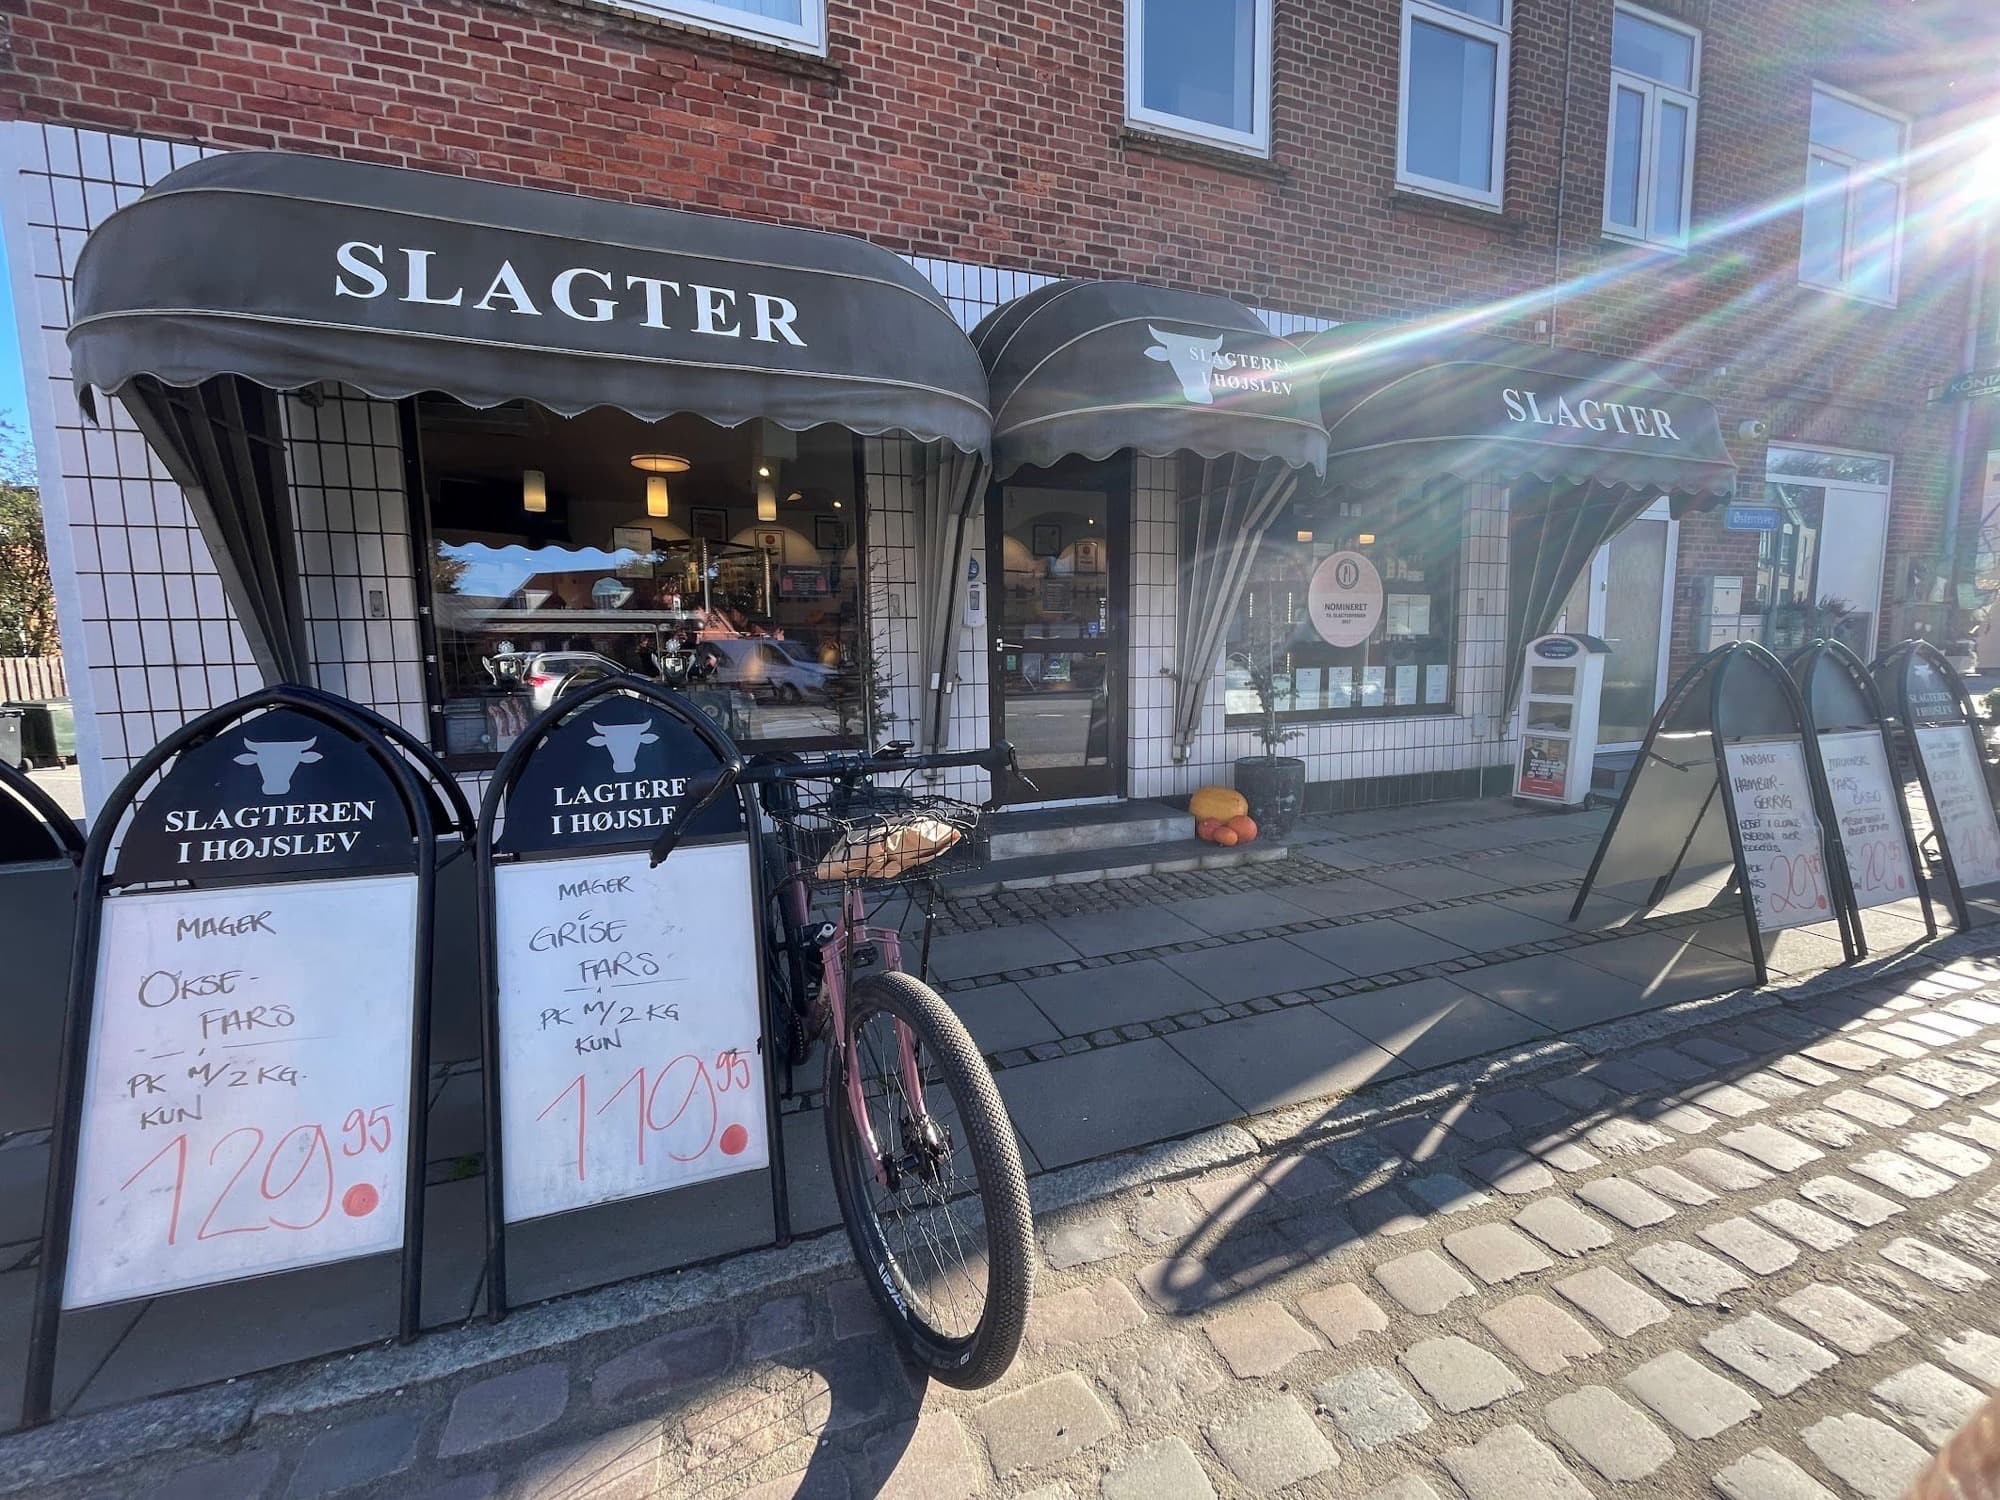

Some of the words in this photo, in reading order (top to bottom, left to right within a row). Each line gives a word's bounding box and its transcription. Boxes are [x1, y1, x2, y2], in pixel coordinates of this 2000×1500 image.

[335, 241, 808, 347] SLAGTER
[1189, 346, 1293, 373] SLAGTEREN
[1213, 373, 1292, 396] HØJSLEV
[1501, 387, 1681, 441] SLAGTER
[1324, 602, 1368, 611] NOMINERET
[553, 777, 692, 806] LAGTERE
[165, 800, 376, 833] SLAGTEREN
[551, 815, 563, 834] I
[570, 805, 677, 833] HØJSLE
[177, 842, 192, 864] I
[199, 831, 361, 863] HØJSLEV
[559, 875, 634, 900] MAGER
[176, 910, 276, 942] MAGER
[579, 951, 660, 984] FARS
[200, 1004, 296, 1040] FARS
[540, 1008, 574, 1030] PK
[646, 1003, 680, 1022] KG
[575, 1028, 622, 1055] KUN
[127, 1073, 166, 1098] PK
[140, 1094, 203, 1130] KUN
